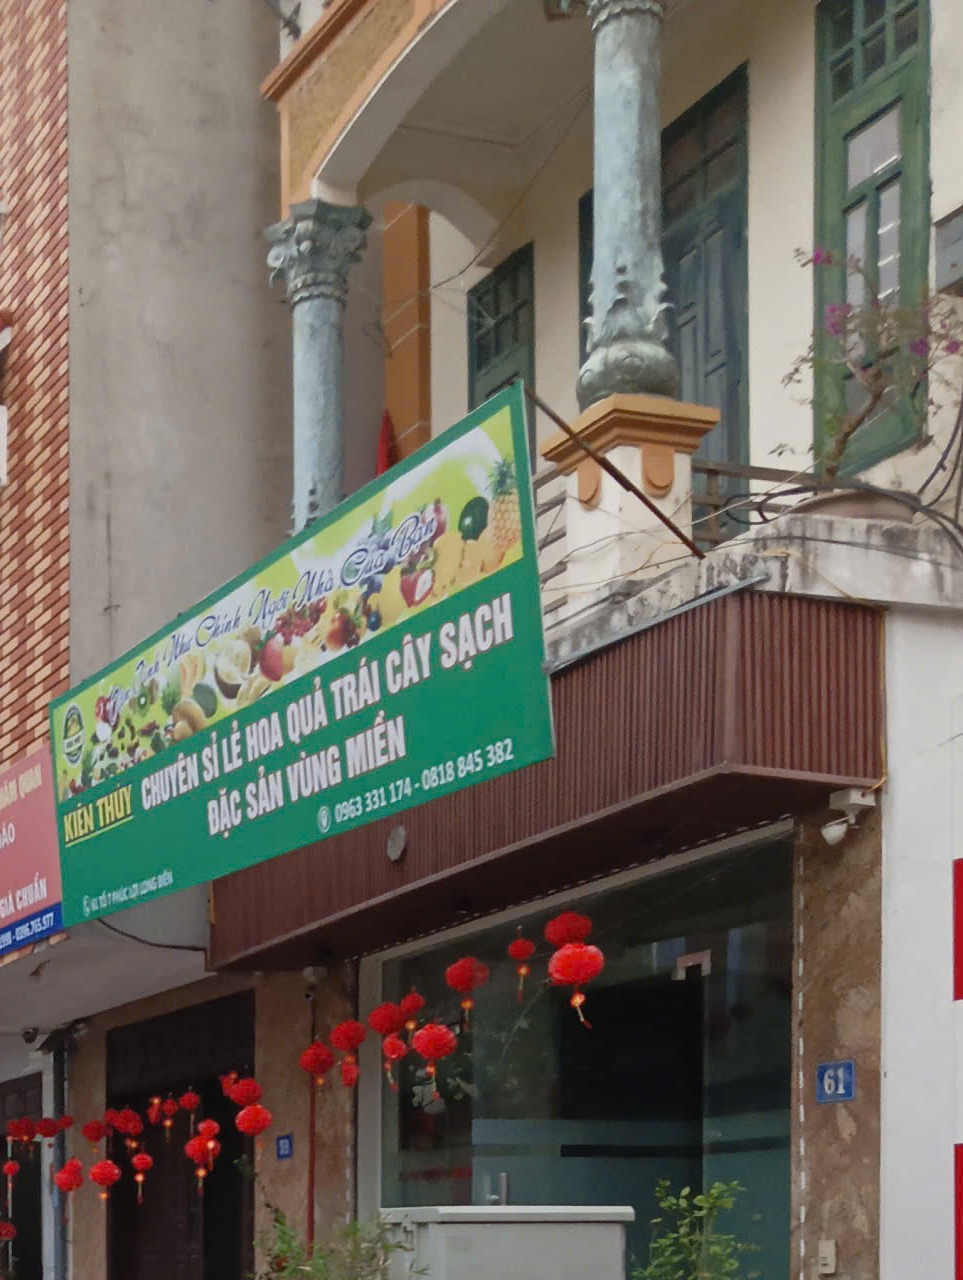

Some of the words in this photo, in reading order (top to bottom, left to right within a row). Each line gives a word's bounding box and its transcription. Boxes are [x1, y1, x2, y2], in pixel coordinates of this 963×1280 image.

[195, 605, 242, 647] Chính
[292, 570, 334, 609] Nhà
[391, 514, 436, 558] Bạn
[141, 752, 199, 810] CHUYÊN
[202, 731, 220, 782] SỈ
[222, 720, 243, 773] LẺ
[245, 711, 284, 762] HOA
[286, 676, 328, 744] QUẢ
[330, 657, 381, 721] TRÁI
[385, 633, 432, 695] CÂY
[439, 592, 514, 670] SẠCH
[207, 786, 242, 839] ĐẶC
[245, 765, 284, 820] SẢN
[286, 751, 342, 803] VÙNG
[334, 795, 363, 823] 0963
[365, 787, 386, 812] 331
[389, 777, 412, 802] 174
[421, 760, 455, 790] 0818
[457, 749, 484, 779] 845
[486, 738, 514, 767] 382
[823, 1067, 845, 1095] 61
